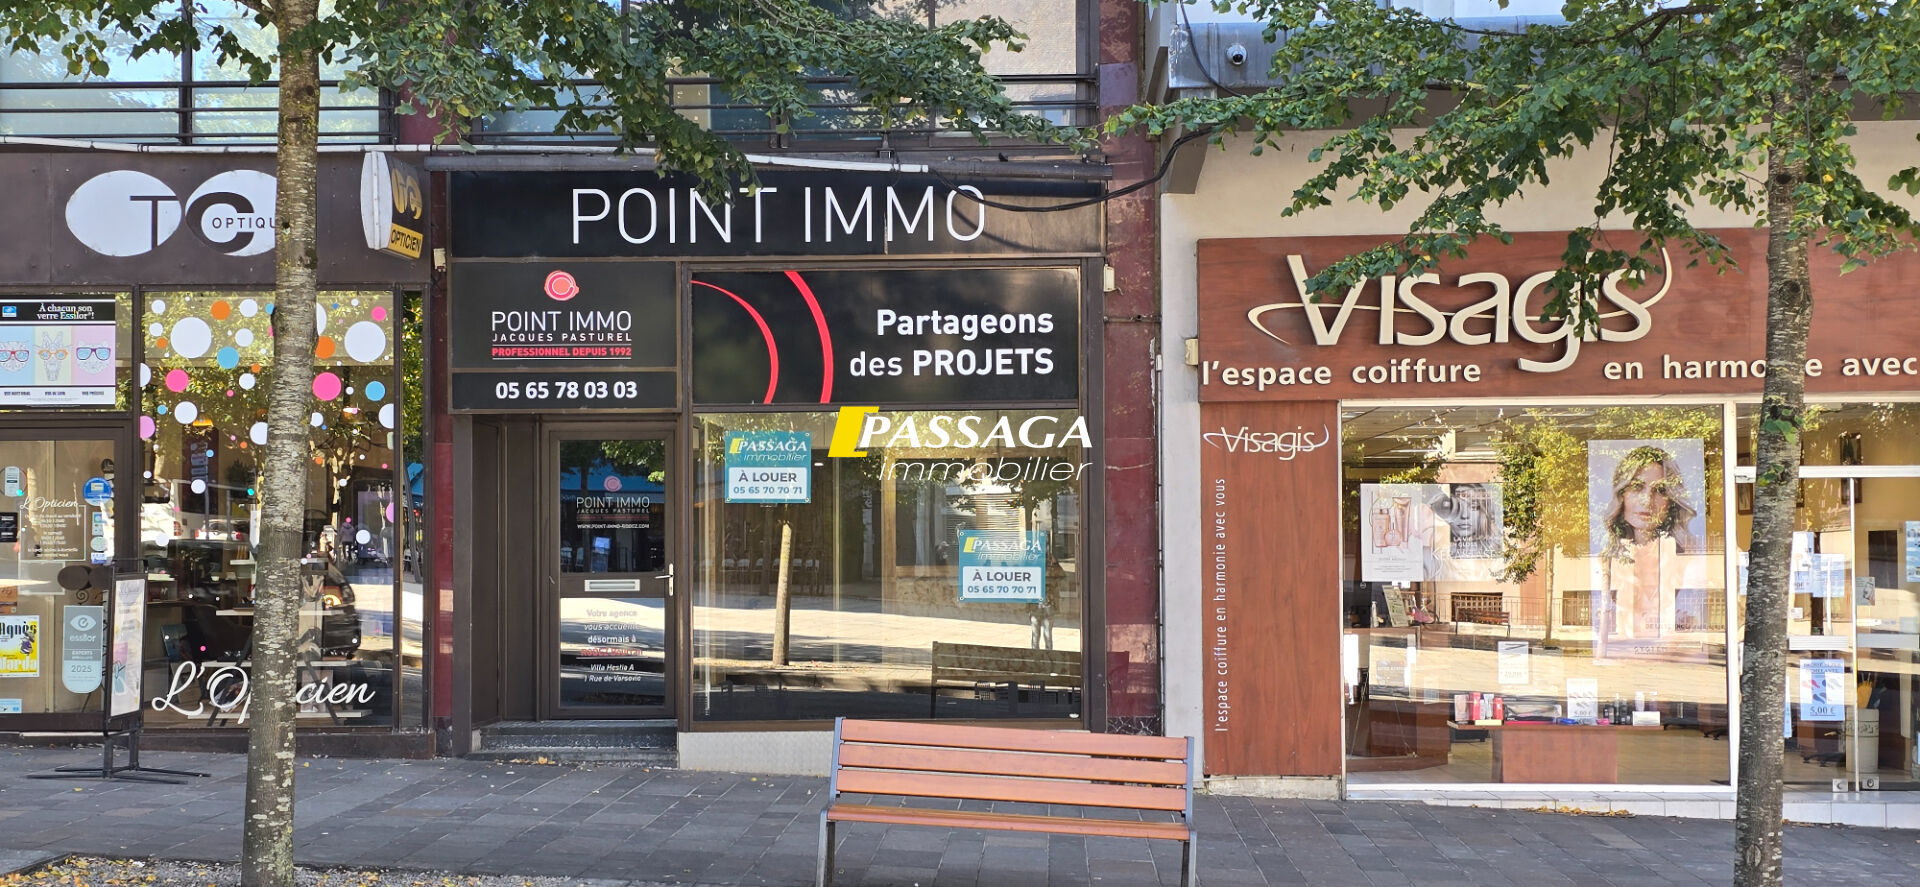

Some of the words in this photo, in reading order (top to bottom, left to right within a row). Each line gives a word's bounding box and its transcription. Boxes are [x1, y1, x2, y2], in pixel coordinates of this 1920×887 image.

[572, 187, 778, 244] POINT
[804, 185, 986, 242] IMMO
[212, 217, 276, 229] OPTIQU
[390, 229, 420, 253] OPTICIEN
[39, 302, 46, 312] À
[47, 304, 76, 312] chacun
[491, 311, 562, 332] POINT
[569, 310, 632, 331] IMMO
[876, 309, 1054, 341] Partageons
[492, 333, 553, 342] JACQUES
[561, 332, 632, 341] PASTUREL
[491, 347, 570, 357] PROFESSIONNEL
[572, 347, 607, 356] DEPUIS
[609, 347, 632, 356] 1992
[849, 351, 903, 377] des
[913, 347, 1054, 376] PROJETS
[1202, 360, 1332, 391] l'espace
[1352, 358, 1481, 384] coiffure
[1603, 361, 1644, 380] en
[1661, 354, 1823, 380] harmoe
[1841, 356, 1918, 377] avec
[495, 382, 520, 399] 05
[525, 382, 550, 399] 65
[554, 381, 579, 399] 78
[584, 381, 608, 399] 03
[613, 381, 638, 399] 03
[738, 440, 807, 452] PASSAGA
[1220, 425, 1316, 460] Visagis
[743, 452, 808, 462] immobilier
[738, 469, 749, 482] À
[752, 472, 797, 482] LOUER
[733, 486, 746, 495] 05
[748, 486, 760, 495] 65
[762, 486, 775, 495] 70
[777, 486, 790, 495] 70
[792, 486, 803, 495] 71
[1215, 478, 1226, 506] vous
[576, 496, 613, 508] POINT
[616, 496, 650, 508] IMMO
[1215, 511, 1226, 539] avec
[972, 539, 1042, 551] PASSAGA
[972, 568, 983, 582] À
[986, 571, 1032, 582] LOUER
[1212, 544, 1226, 601] harmonie
[967, 585, 980, 594] 05
[982, 585, 994, 594] 65
[996, 585, 1009, 594] 70
[1011, 585, 1024, 594] 70
[1026, 585, 1037, 594] 71
[586, 609, 608, 617] Votre
[609, 610, 638, 618] agence
[1216, 607, 1226, 621] en
[70, 633, 97, 642] essilor
[588, 634, 630, 643] désormais
[631, 634, 637, 643] à
[1213, 626, 1228, 676] coiffure
[71, 665, 92, 673] 2025
[1214, 681, 1231, 732] l'espace
[1810, 706, 1828, 716] 5,00
